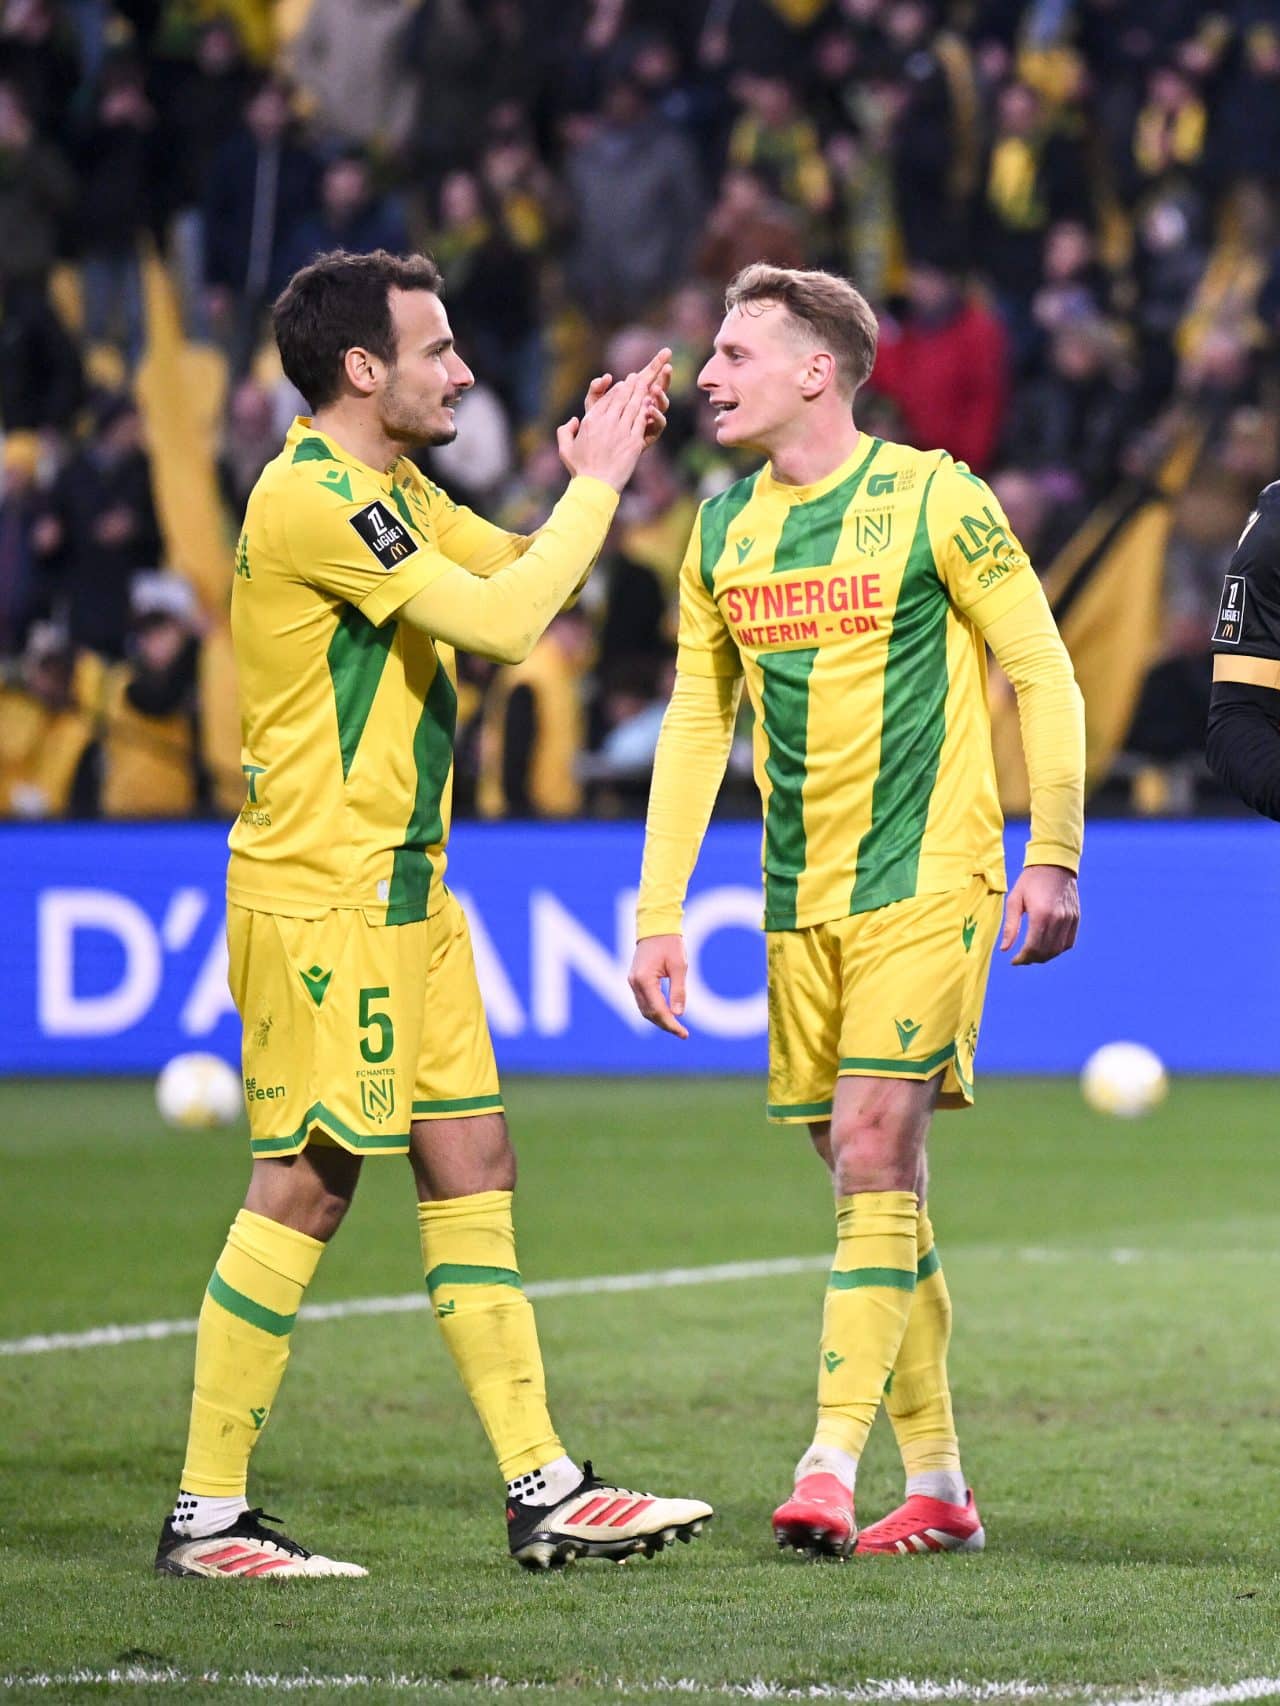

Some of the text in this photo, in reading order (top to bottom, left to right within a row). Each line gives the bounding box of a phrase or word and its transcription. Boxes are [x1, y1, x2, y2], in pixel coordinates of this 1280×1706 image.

[373, 527, 400, 552] LIGUE
[727, 573, 883, 624] SYNERGIE
[737, 621, 819, 646] INTERIM
[840, 615, 879, 635] CDI
[359, 986, 394, 1064] 5
[366, 1067, 396, 1076] NANTES
